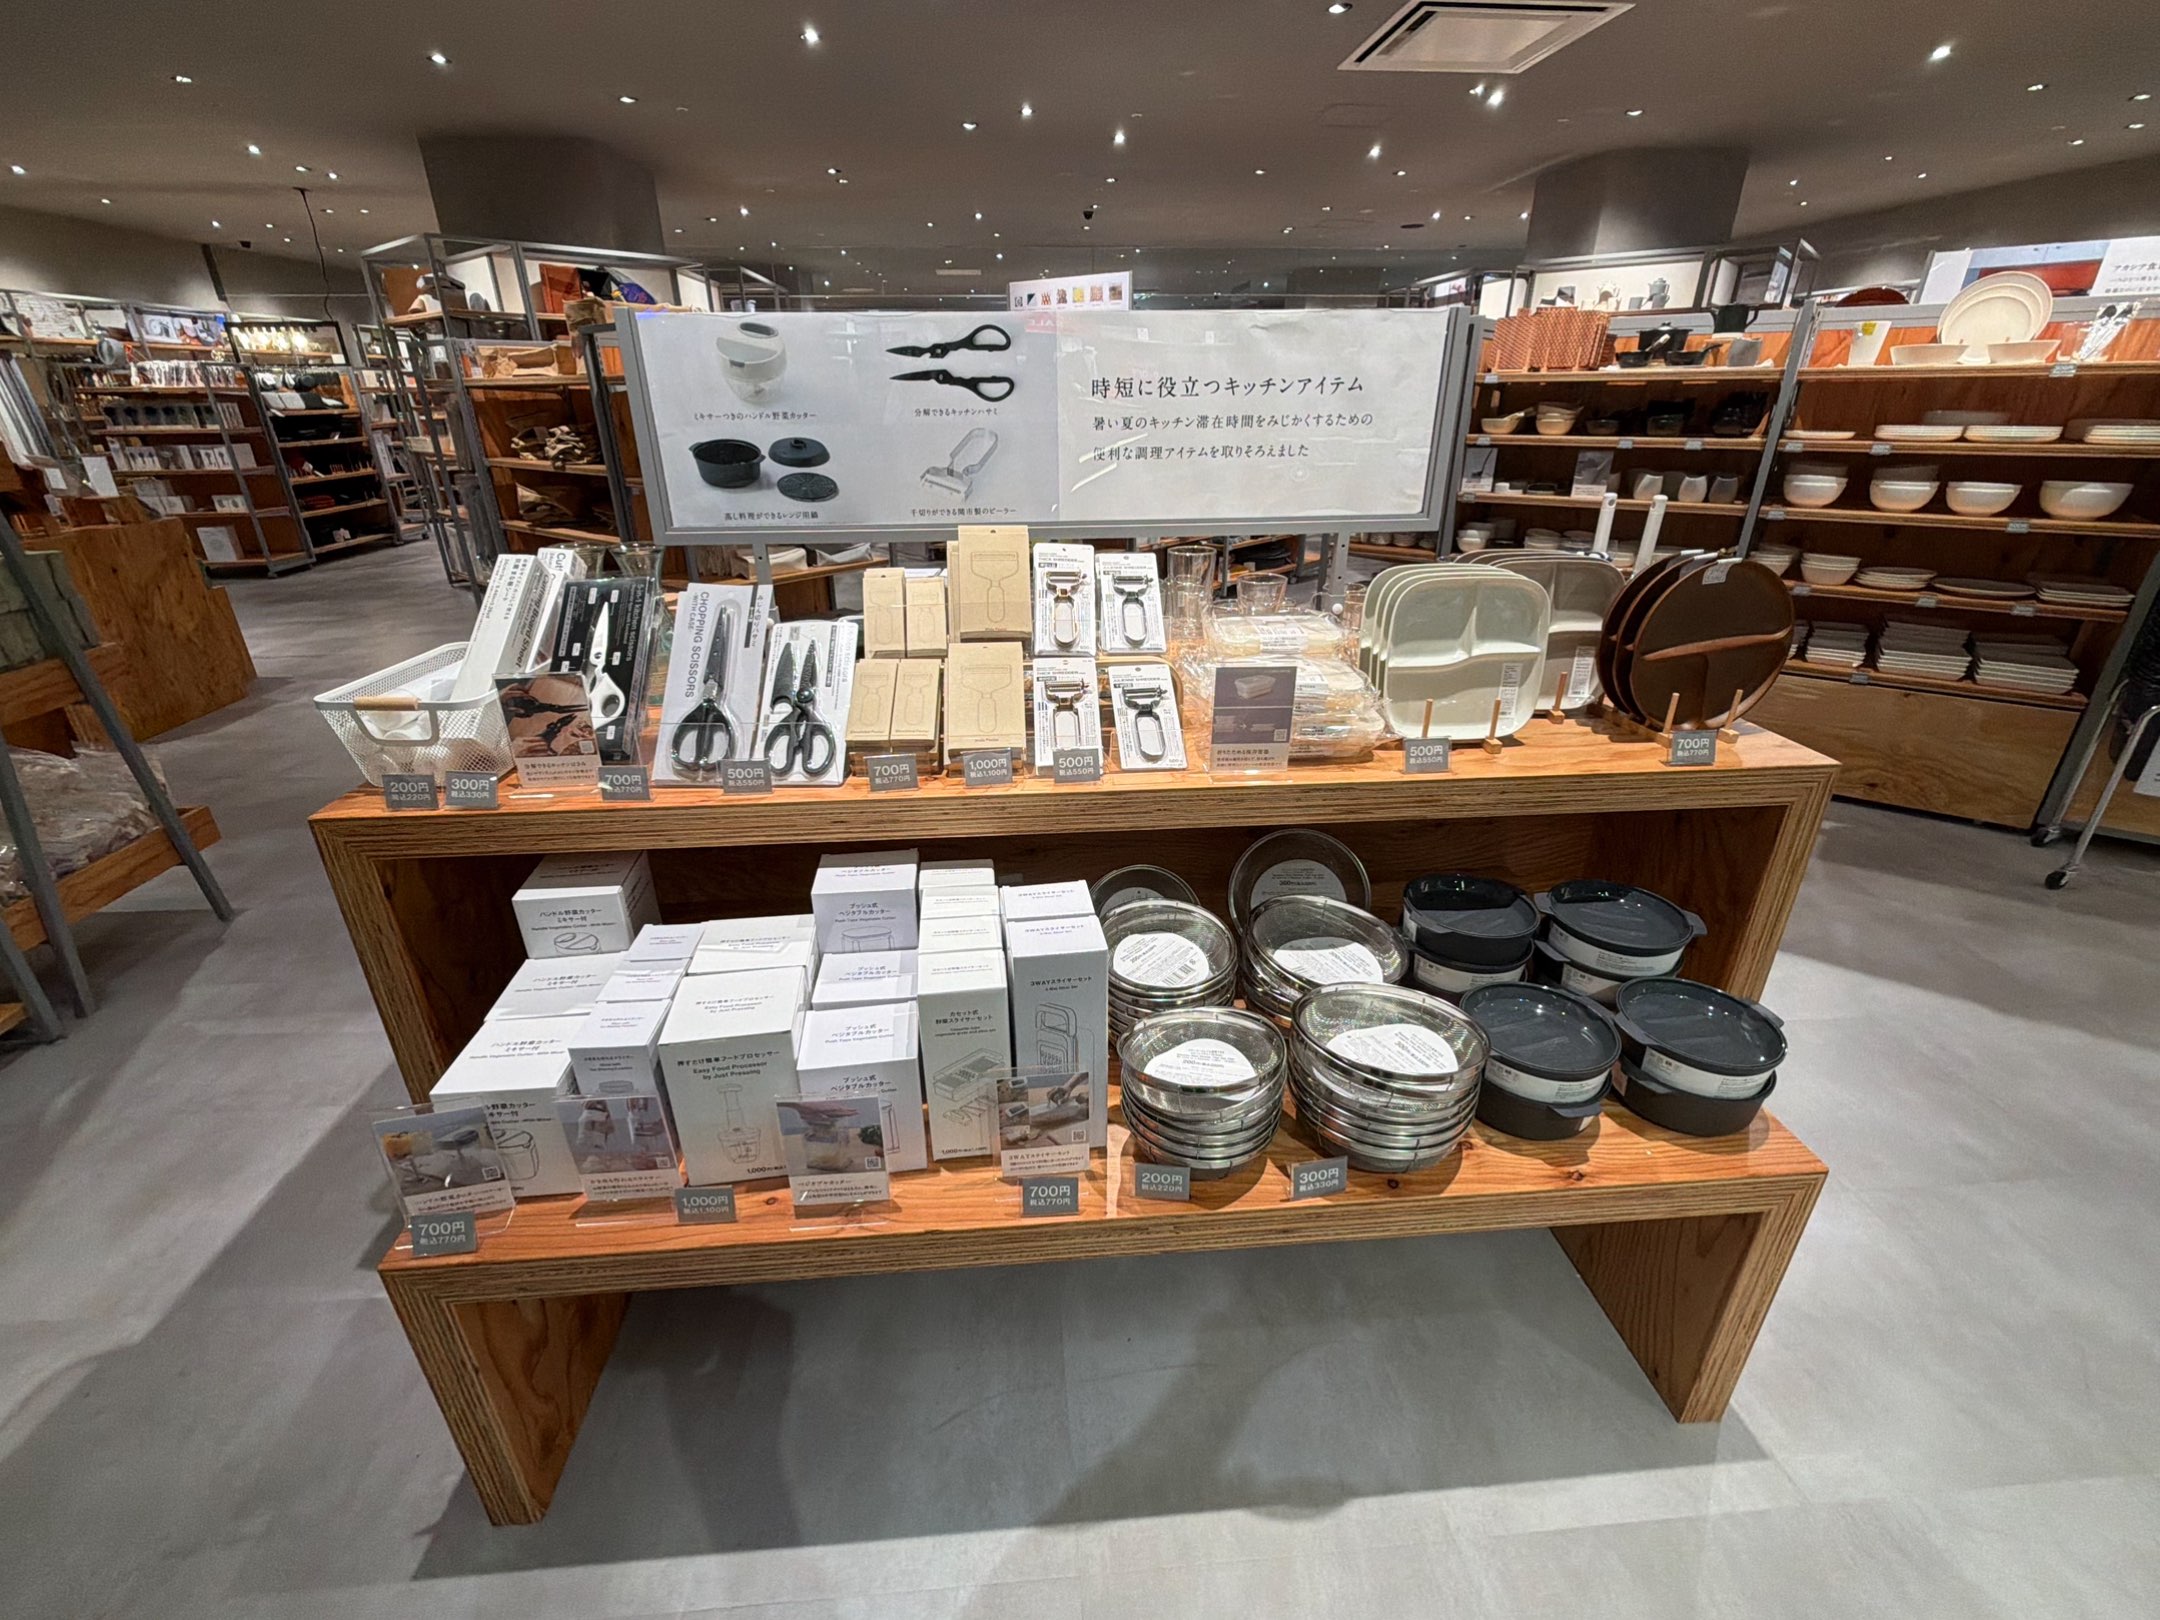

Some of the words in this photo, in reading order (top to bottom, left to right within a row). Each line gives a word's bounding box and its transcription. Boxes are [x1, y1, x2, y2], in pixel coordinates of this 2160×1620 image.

[1091, 376, 1364, 398] 時短に役立つキッチンアイテム
[914, 408, 998, 416] 分解できるキッチンハサミ
[1092, 413, 1373, 431] 暑い夏のキッチン滞在時間をみじかくするための
[1092, 444, 1309, 462] 便利な調理アイテムを取りそろえました
[693, 591, 710, 645] CHOPPING
[685, 644, 702, 698] SCISSORS
[1677, 738, 1710, 749] 700円
[1410, 745, 1442, 756] 500円
[969, 758, 1007, 772] 1,000円
[1058, 756, 1094, 768] 500円
[727, 768, 764, 778] 500円
[874, 764, 910, 776] 700円
[1059, 768, 1094, 776] 税込550円
[451, 778, 489, 790] 300円
[604, 774, 642, 785] 700円
[728, 779, 765, 787] 税込550円
[874, 774, 912, 784] 税込770円
[390, 782, 430, 793] 200円
[1030, 976, 1092, 986] 3WAYスライサーセット
[678, 1051, 780, 1066] 押すだけ簡単フードプロセッサー
[732, 1062, 768, 1070] Processor
[1142, 1172, 1182, 1185] 200円
[1300, 1168, 1339, 1184] 300円
[1030, 1185, 1070, 1197] 700円
[1142, 1184, 1182, 1192] 税込220円
[1299, 1180, 1339, 1192] 税込330円
[682, 1196, 728, 1208] 1,000円
[1030, 1198, 1071, 1206] 税込770円
[419, 1221, 466, 1236] 700円
[420, 1234, 466, 1246] 税込770円
